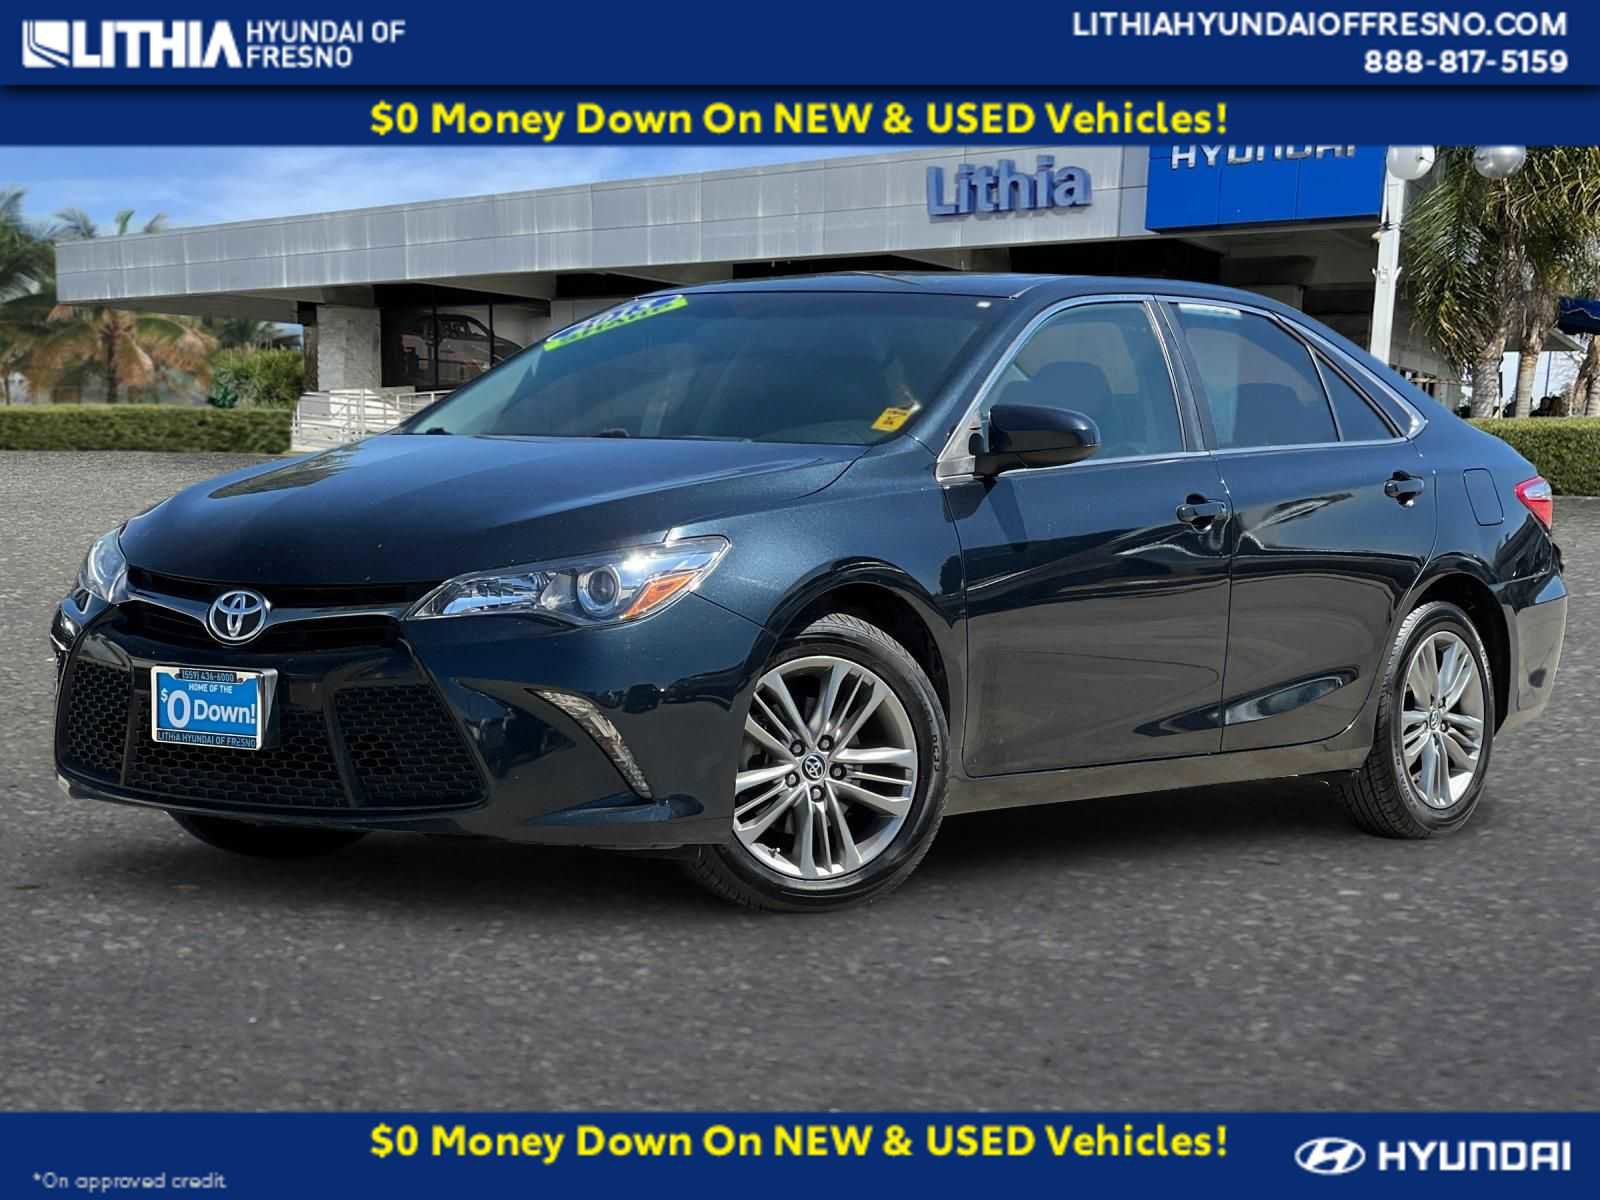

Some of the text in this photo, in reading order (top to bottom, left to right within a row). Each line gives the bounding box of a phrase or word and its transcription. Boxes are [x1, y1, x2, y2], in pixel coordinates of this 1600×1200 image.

[926, 154, 1092, 217] Lithia
[188, 683, 233, 694] HOME OF THE
[193, 699, 256, 725] Down!
[157, 731, 257, 748] LITHIA HYUNDAI OF FRESNO
